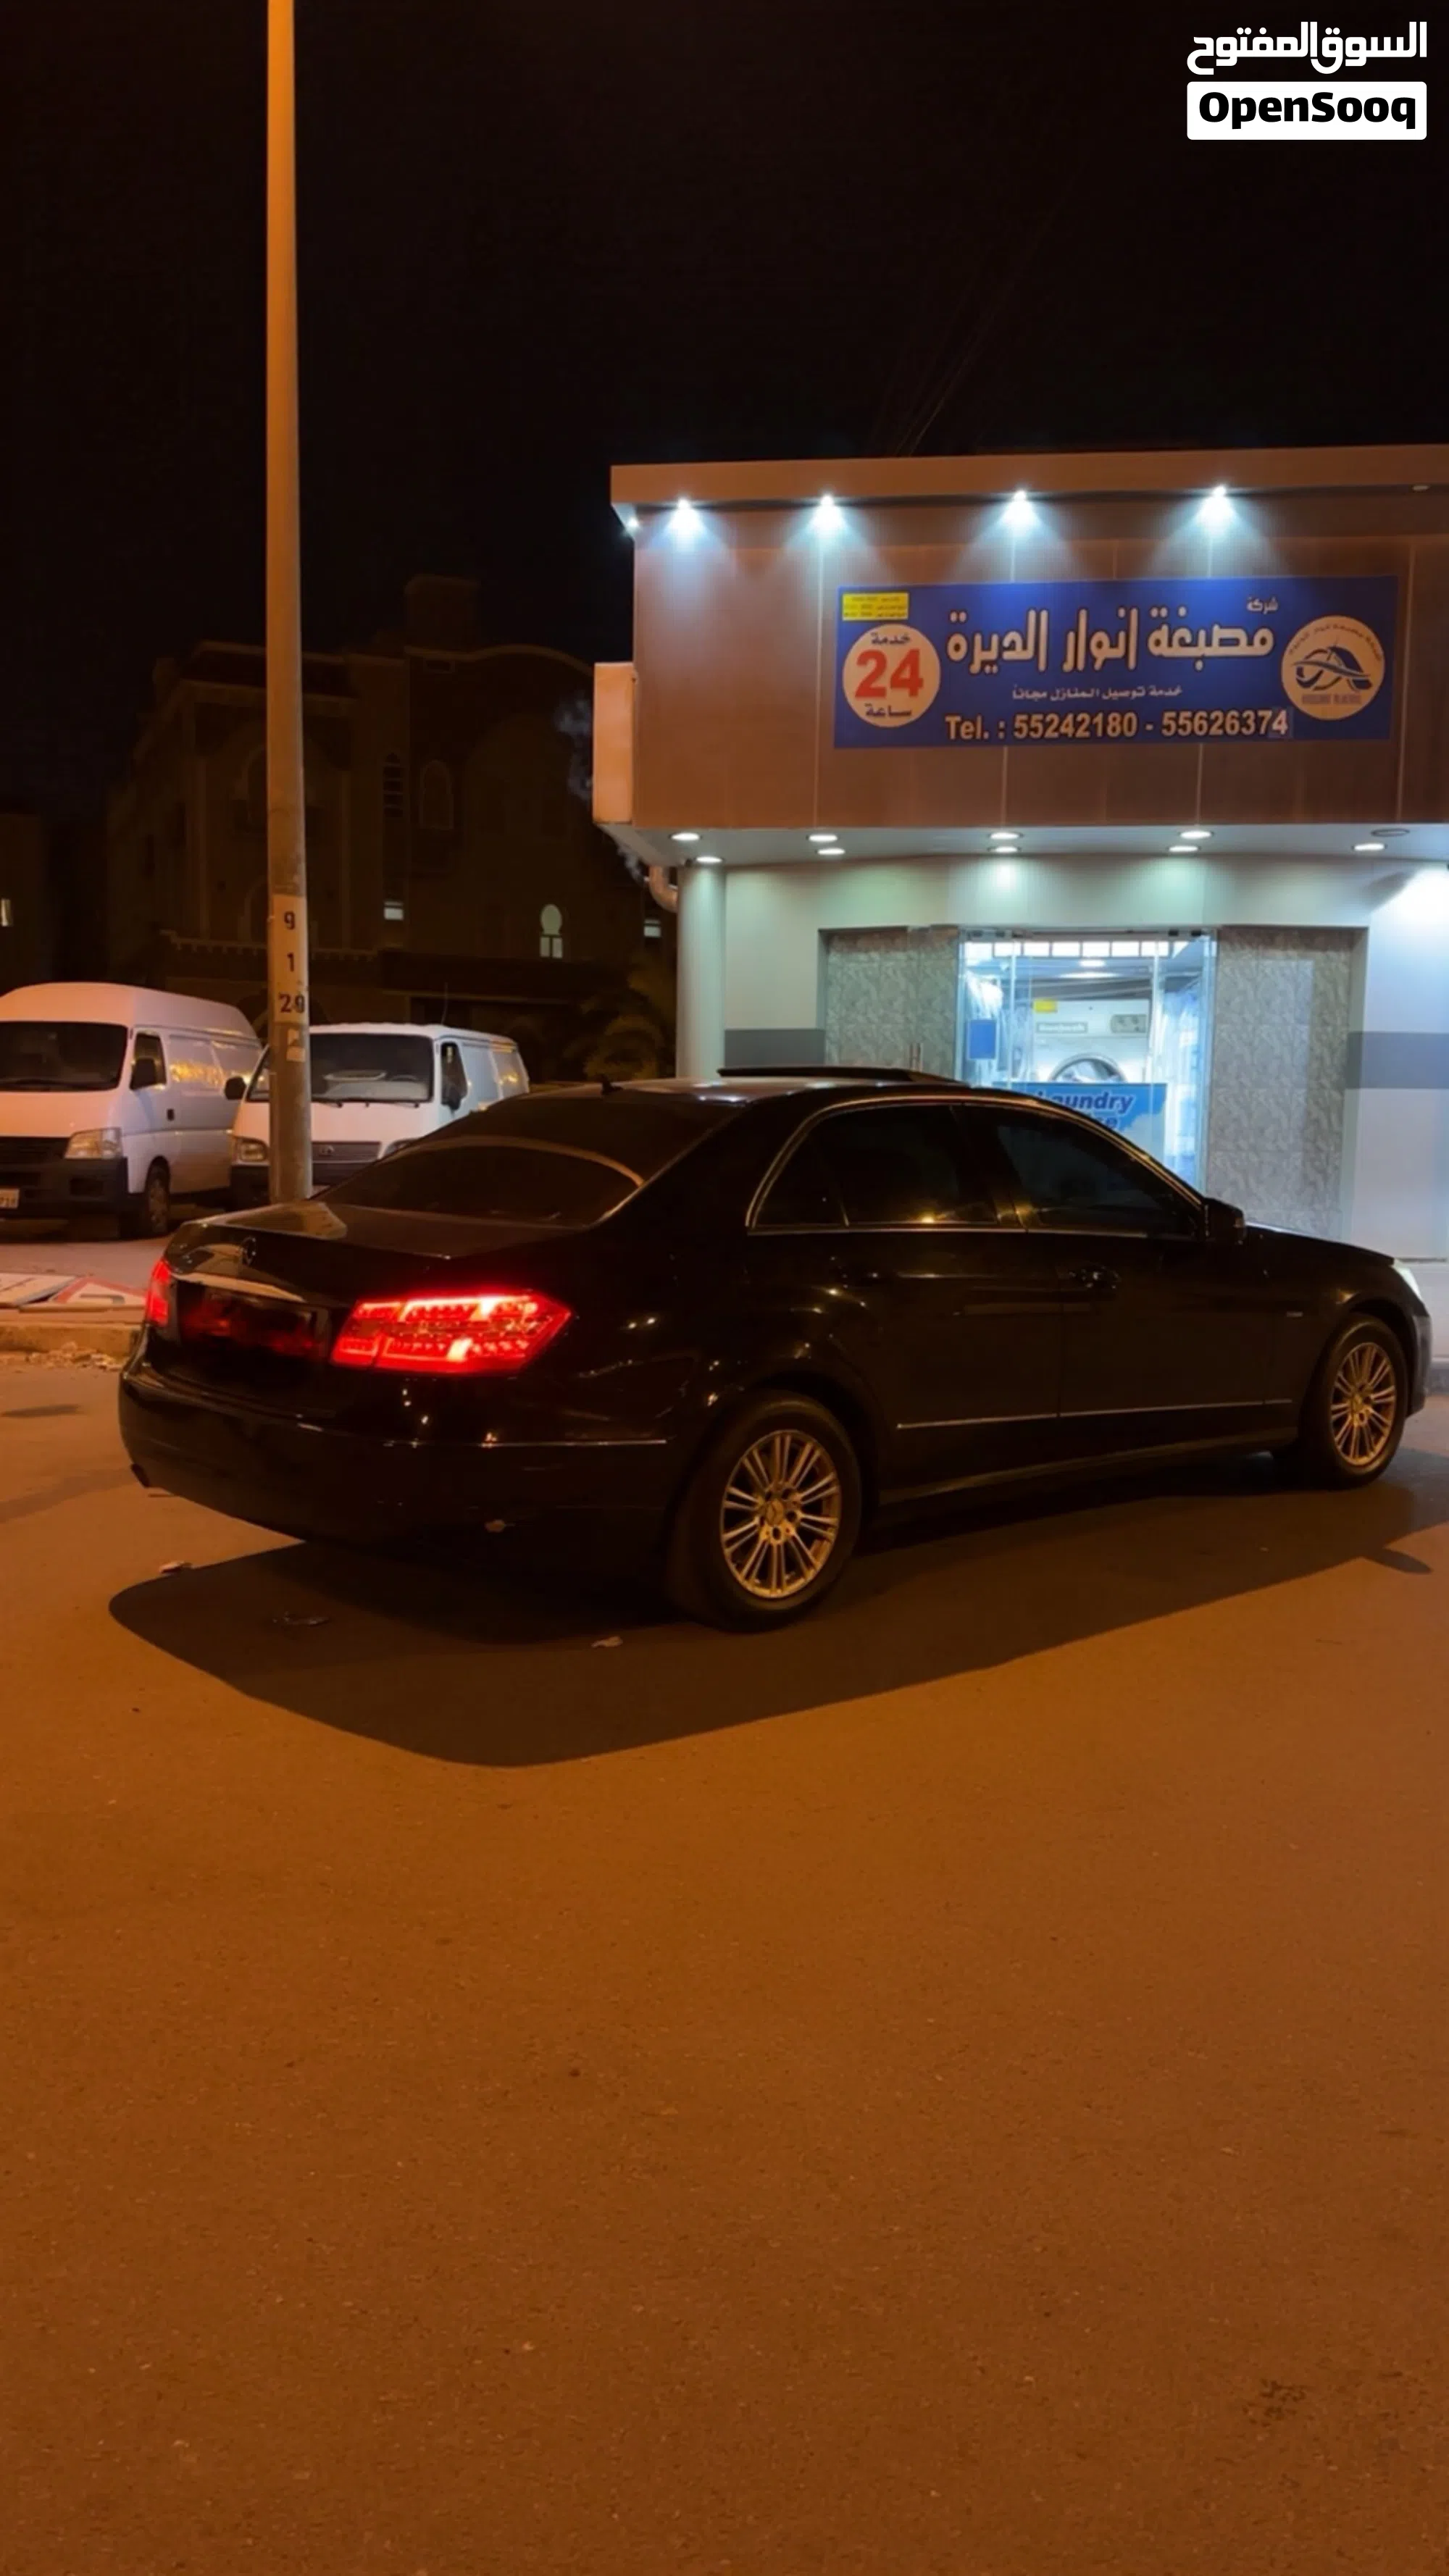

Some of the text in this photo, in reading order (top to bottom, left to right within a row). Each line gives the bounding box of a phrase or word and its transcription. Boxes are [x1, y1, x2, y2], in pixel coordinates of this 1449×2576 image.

[1246, 596, 1279, 614] شركة
[871, 632, 911, 645] خدمة
[947, 609, 1048, 674] الديرة
[1062, 607, 1139, 673] انوار
[1148, 606, 1274, 671] مصبغة
[855, 648, 924, 699] 24
[1050, 687, 1100, 701] المنازل
[1101, 685, 1145, 700] توصيل
[1148, 685, 1182, 697] خدمة
[864, 703, 913, 717] ساعة
[945, 714, 990, 740] Tel.
[998, 721, 1005, 739] :
[1014, 711, 1138, 740] 55242180
[1161, 709, 1289, 737] 55626374
[283, 911, 296, 930] 9
[286, 953, 294, 972] 1
